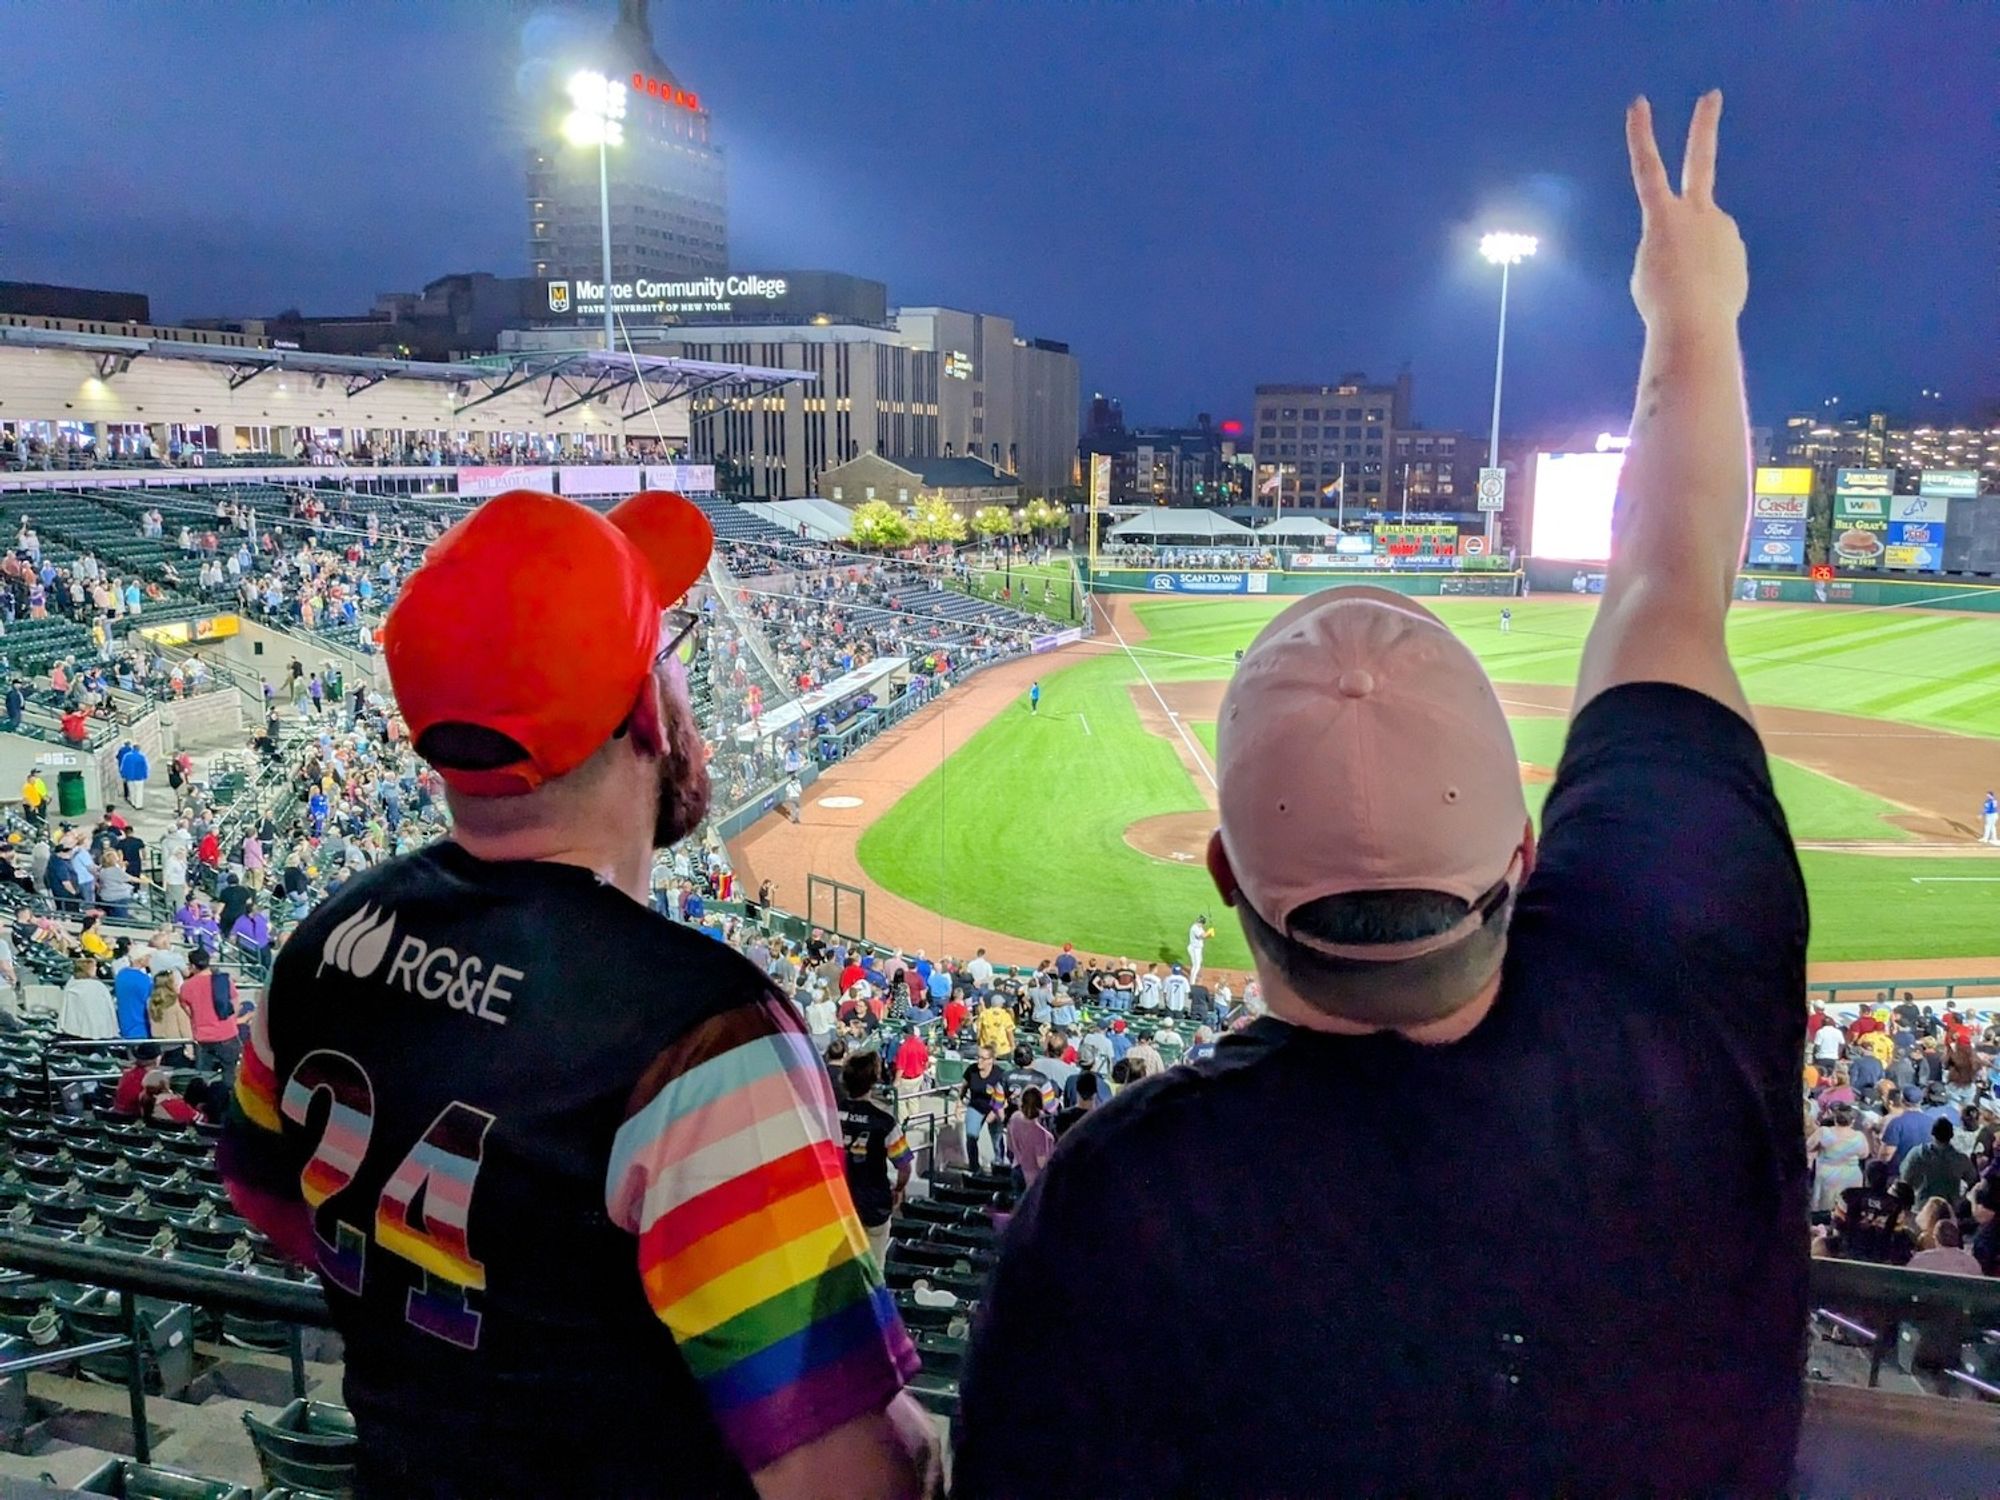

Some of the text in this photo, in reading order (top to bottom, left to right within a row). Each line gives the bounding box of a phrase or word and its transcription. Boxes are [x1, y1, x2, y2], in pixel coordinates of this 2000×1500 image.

[576, 275, 786, 300] Monroe Community College
[577, 304, 605, 314] STATE
[666, 303, 679, 312] OF
[681, 303, 702, 311] NEW
[704, 302, 731, 311] YORK
[1380, 526, 1451, 534] BALDNESS.com
[1763, 523, 1793, 536] Ford
[1154, 578, 1174, 589] ESL
[1180, 574, 1241, 583] SCAN TO WIN
[1760, 586, 1779, 599] 36
[386, 934, 525, 1025] RG&E
[281, 1049, 496, 1349] 24
